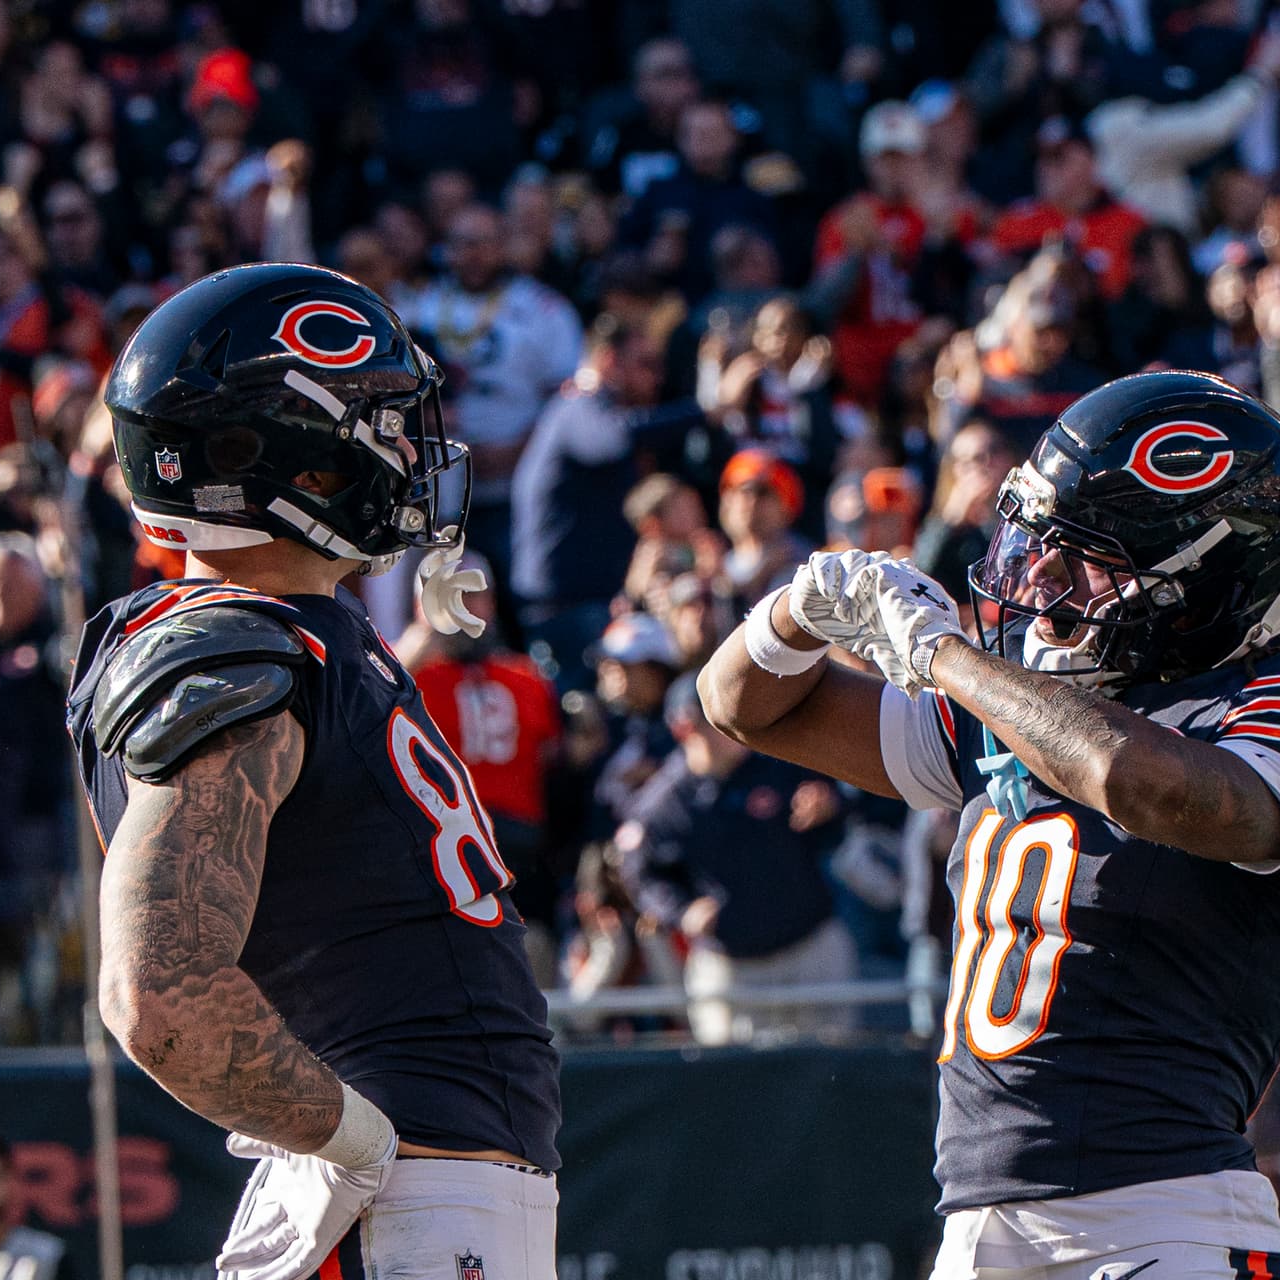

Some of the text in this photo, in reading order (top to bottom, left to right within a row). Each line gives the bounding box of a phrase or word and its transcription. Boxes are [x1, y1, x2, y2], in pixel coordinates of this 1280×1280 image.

[161, 464, 178, 477] NFL
[195, 711, 222, 732] SK
[387, 706, 517, 927] 8
[936, 807, 1080, 1064] 10
